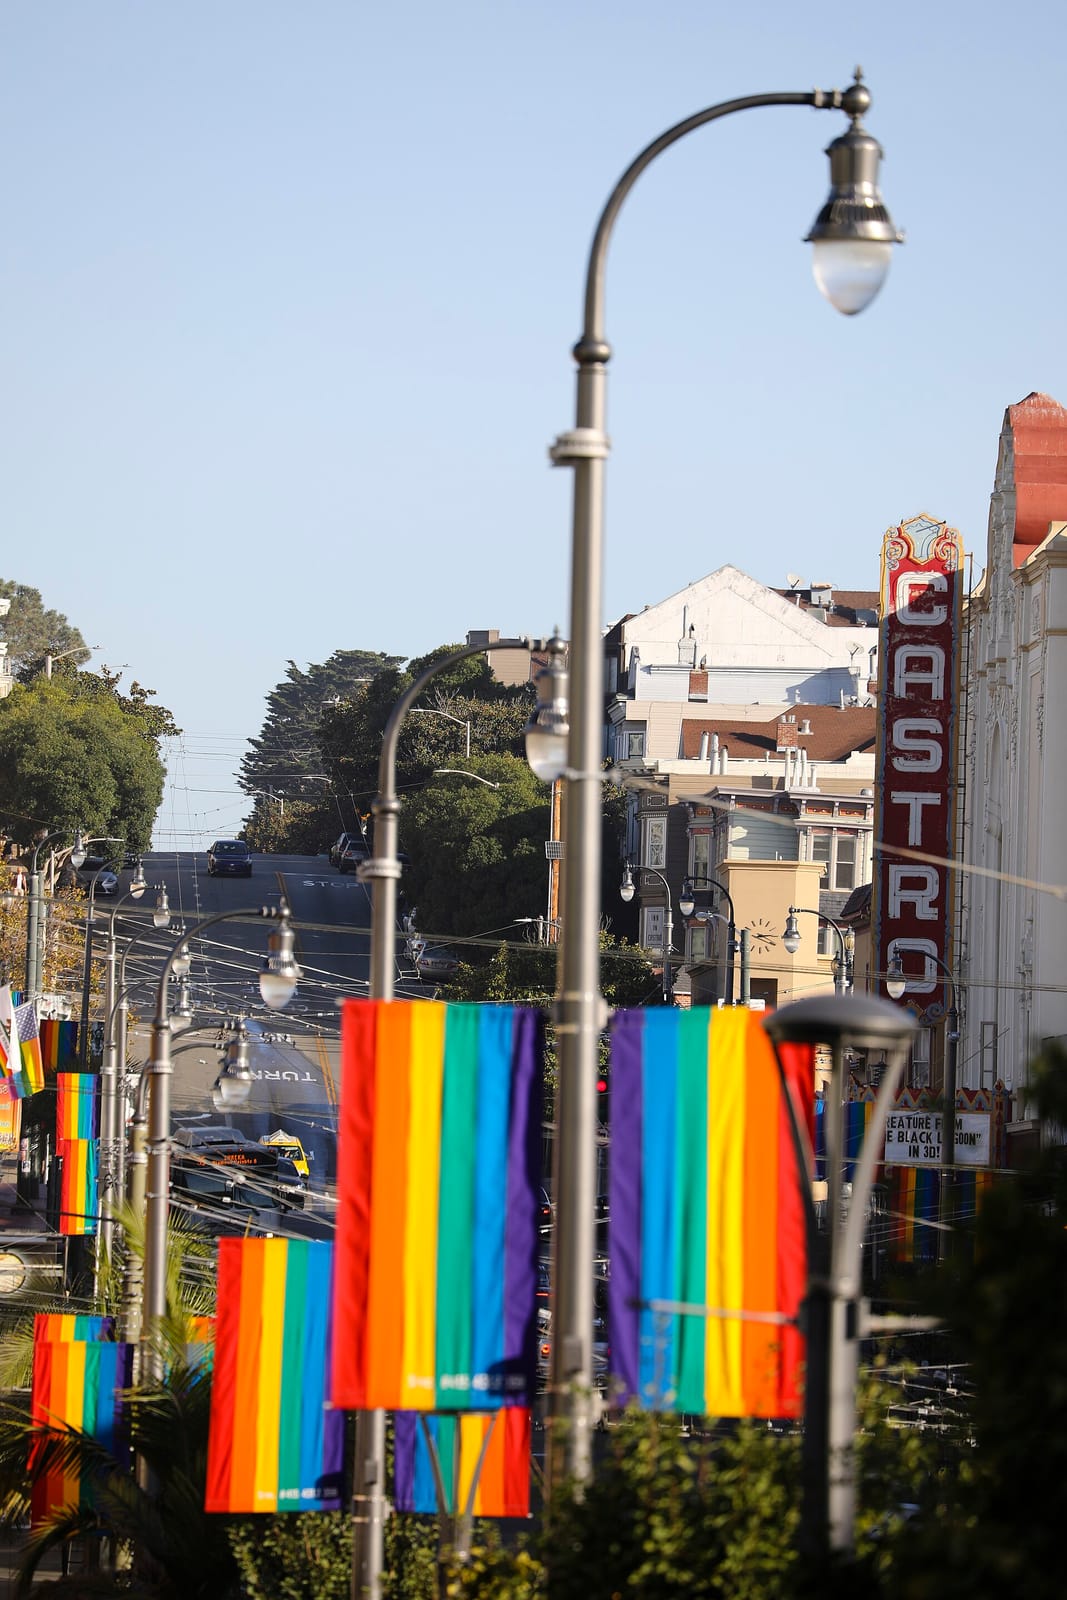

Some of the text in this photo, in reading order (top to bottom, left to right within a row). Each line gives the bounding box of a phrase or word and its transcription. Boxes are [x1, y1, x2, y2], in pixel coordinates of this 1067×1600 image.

[887, 571, 947, 994] CASTRO
[302, 880, 360, 889] STOP
[886, 1116, 963, 1130] REATURE FM
[897, 1131, 933, 1145] BLACK
[937, 1132, 981, 1145] LGOON”
[908, 1145, 941, 1159] IN 3D!
